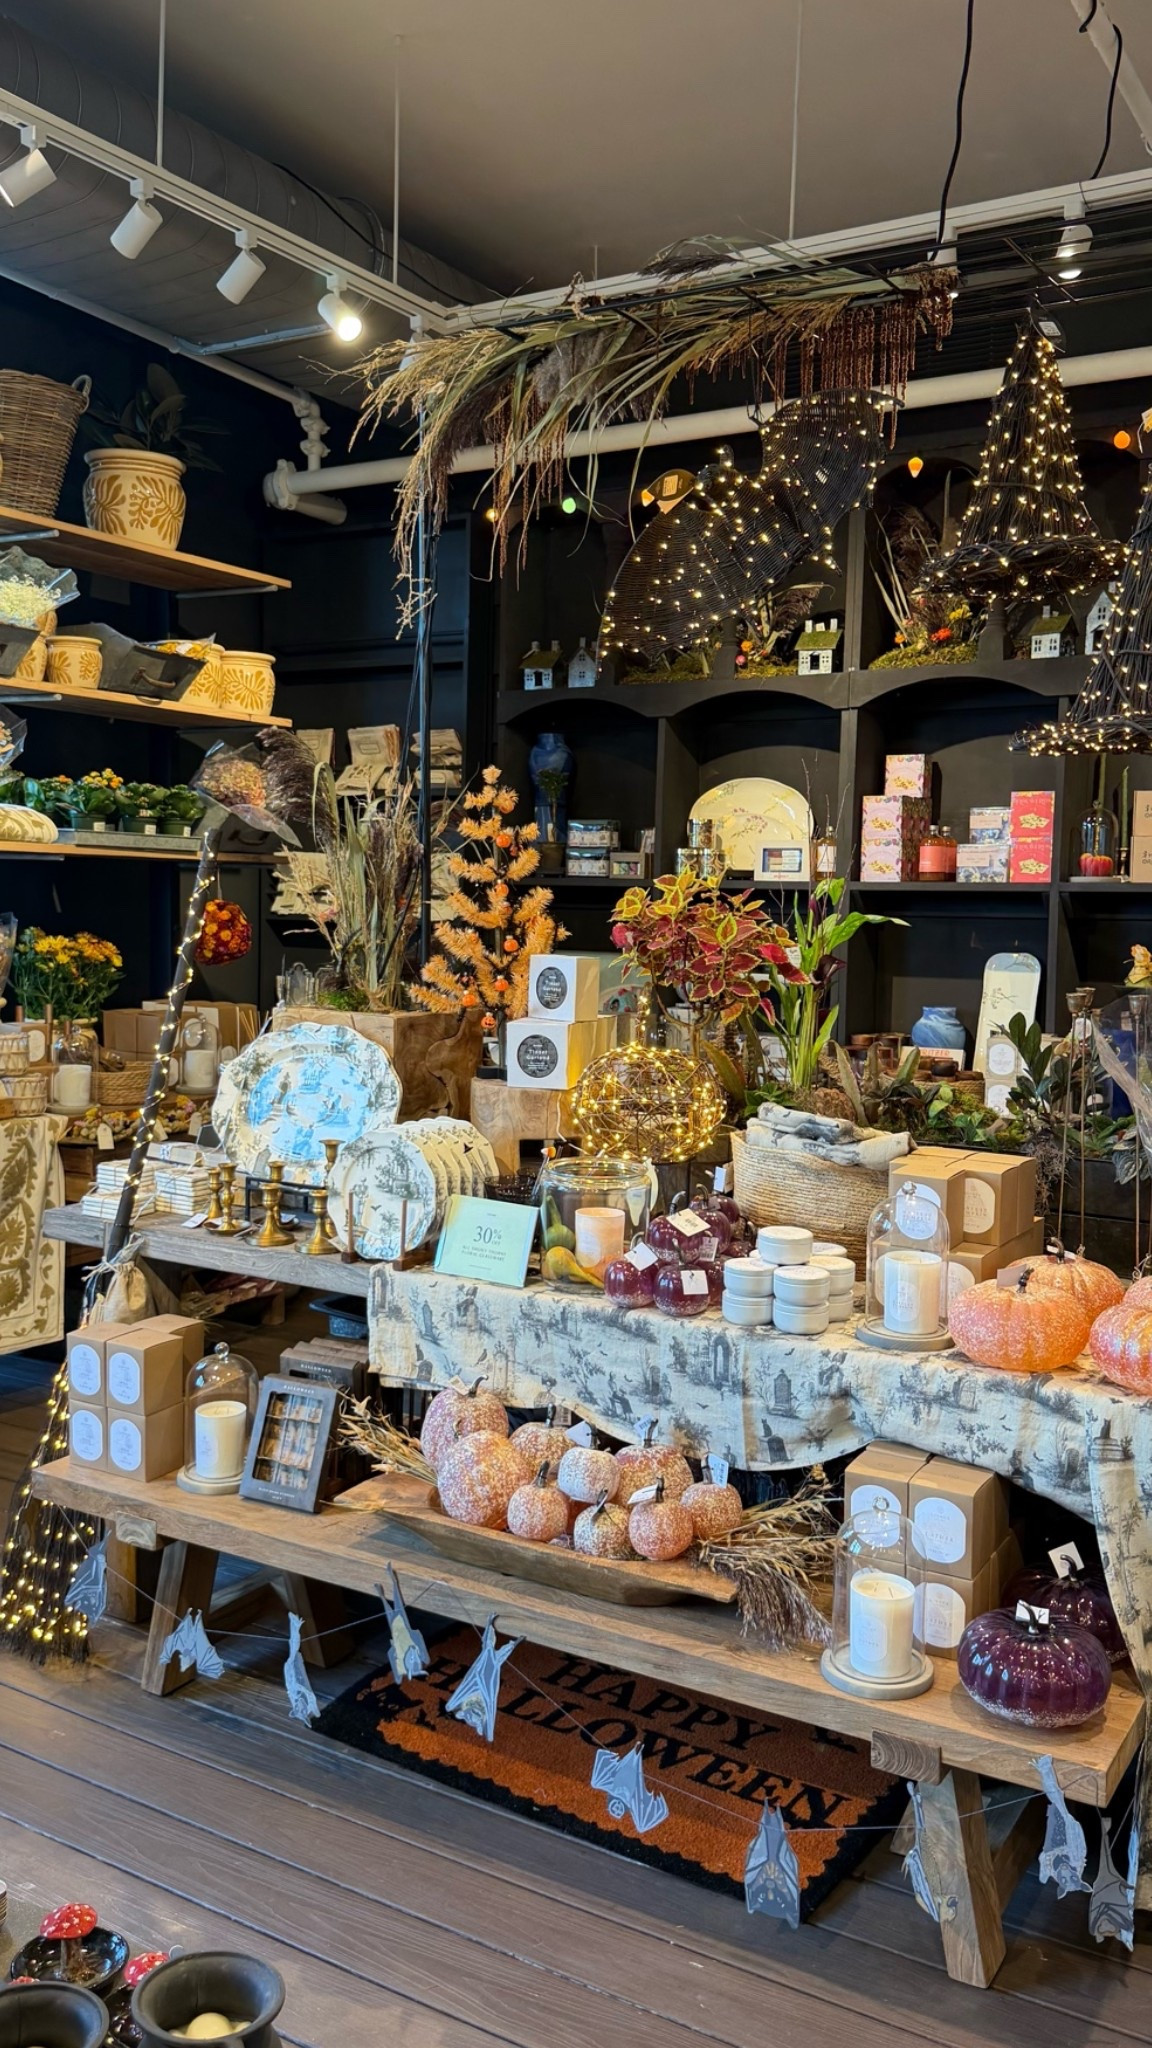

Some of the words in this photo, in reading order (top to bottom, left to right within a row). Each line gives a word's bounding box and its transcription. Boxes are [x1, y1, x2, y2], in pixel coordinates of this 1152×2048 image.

[473, 1225, 502, 1244] 30%
[426, 1655, 852, 1829] HLLOWEEN
[541, 1653, 781, 1749] HAPPY
